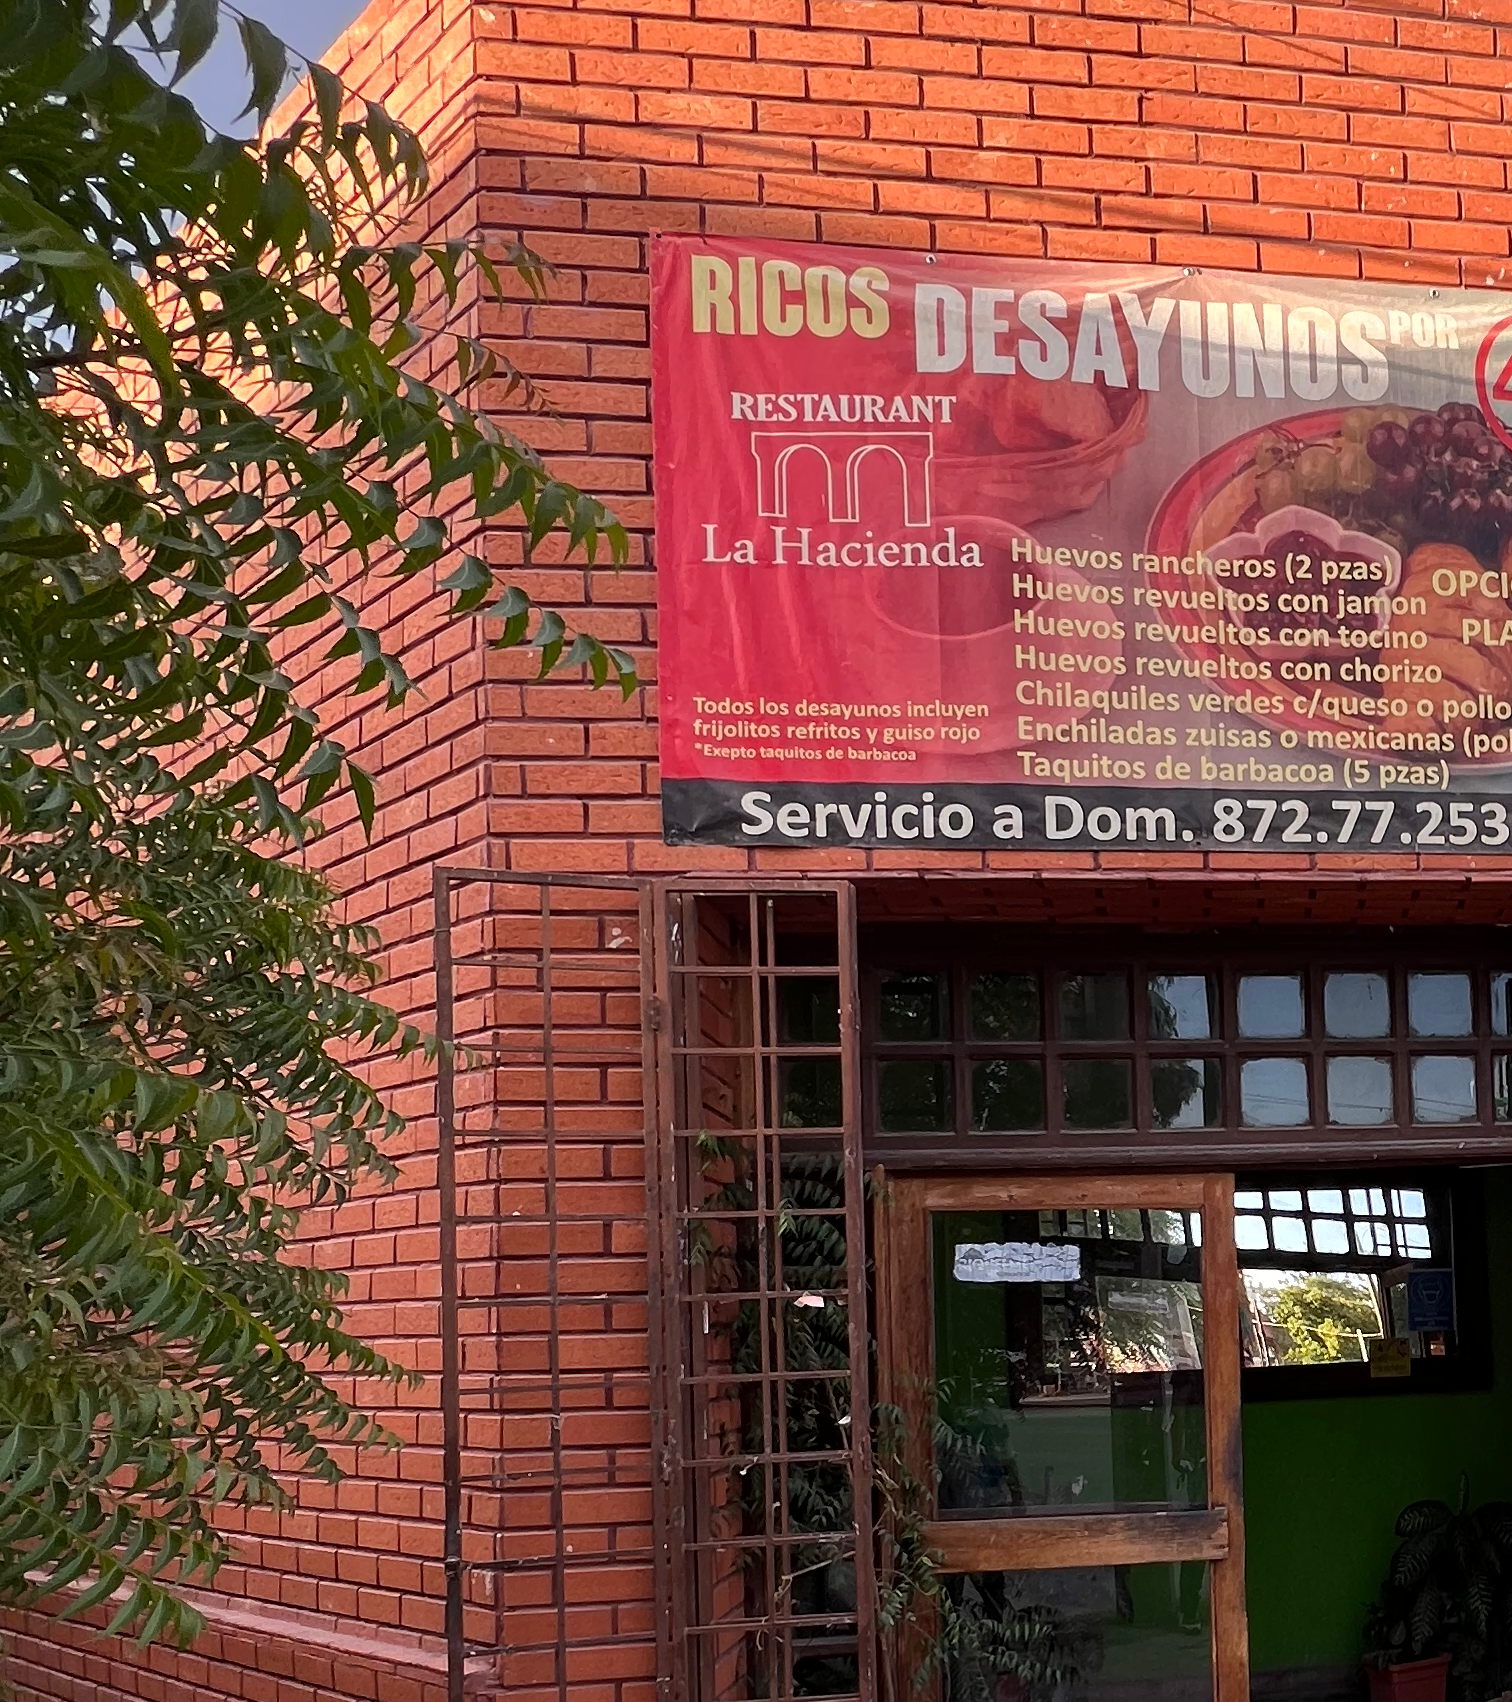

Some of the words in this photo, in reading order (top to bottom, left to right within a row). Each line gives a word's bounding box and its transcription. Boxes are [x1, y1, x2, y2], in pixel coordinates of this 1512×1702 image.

[690, 254, 890, 339] RICOS
[914, 282, 1390, 401] DESAYUNOS
[1389, 309, 1460, 351] POR
[731, 391, 957, 424] RESTAURANT
[701, 523, 758, 566] La
[771, 525, 984, 568] Hacienda
[1011, 537, 1124, 570] Huevos
[1131, 550, 1277, 579] rancheros
[1285, 552, 1312, 584] (2
[1321, 555, 1393, 587] pzas)
[1012, 573, 1125, 605] Huevos
[1133, 583, 1270, 612] revueltos
[1277, 593, 1329, 614] con
[1337, 589, 1427, 619] jamon
[1013, 608, 1126, 640] Huevos
[1134, 619, 1271, 647] revueltos
[1278, 629, 1330, 648] con
[1338, 624, 1428, 650] tocino
[1014, 644, 1127, 676] Huevos
[1135, 653, 1273, 682] revueltos
[1280, 660, 1332, 683] con
[1339, 656, 1443, 684] chorizo
[693, 696, 754, 715] Todos
[759, 697, 789, 716] los
[795, 698, 902, 720] desayunos
[907, 700, 989, 721] incluyen
[1015, 680, 1180, 714] Chilaquiles
[1188, 689, 1285, 715] verdes
[1292, 688, 1408, 720] c/queso
[1416, 699, 1434, 717] o
[1443, 695, 1512, 723] pollo
[693, 718, 780, 742] frijolitos
[787, 720, 861, 740] refritos
[867, 727, 878, 744] y
[883, 722, 935, 745] guiso
[940, 724, 981, 744] rojo
[1016, 715, 1177, 746] Enchiladas
[1185, 722, 1272, 748] zuisas
[1280, 729, 1298, 748] o
[1307, 724, 1455, 752] mexicanas
[760, 745, 822, 762] taquitos
[825, 746, 844, 760] de
[847, 747, 917, 761] barbacoa
[1017, 751, 1146, 783] Taquitos
[1155, 755, 1192, 781] de
[1200, 756, 1335, 783] barbacoa
[1343, 758, 1371, 788] (5
[1379, 759, 1450, 790] pzas)
[740, 790, 974, 840] Servicio
[992, 803, 1024, 840] a
[1044, 795, 1195, 844] Dom.
